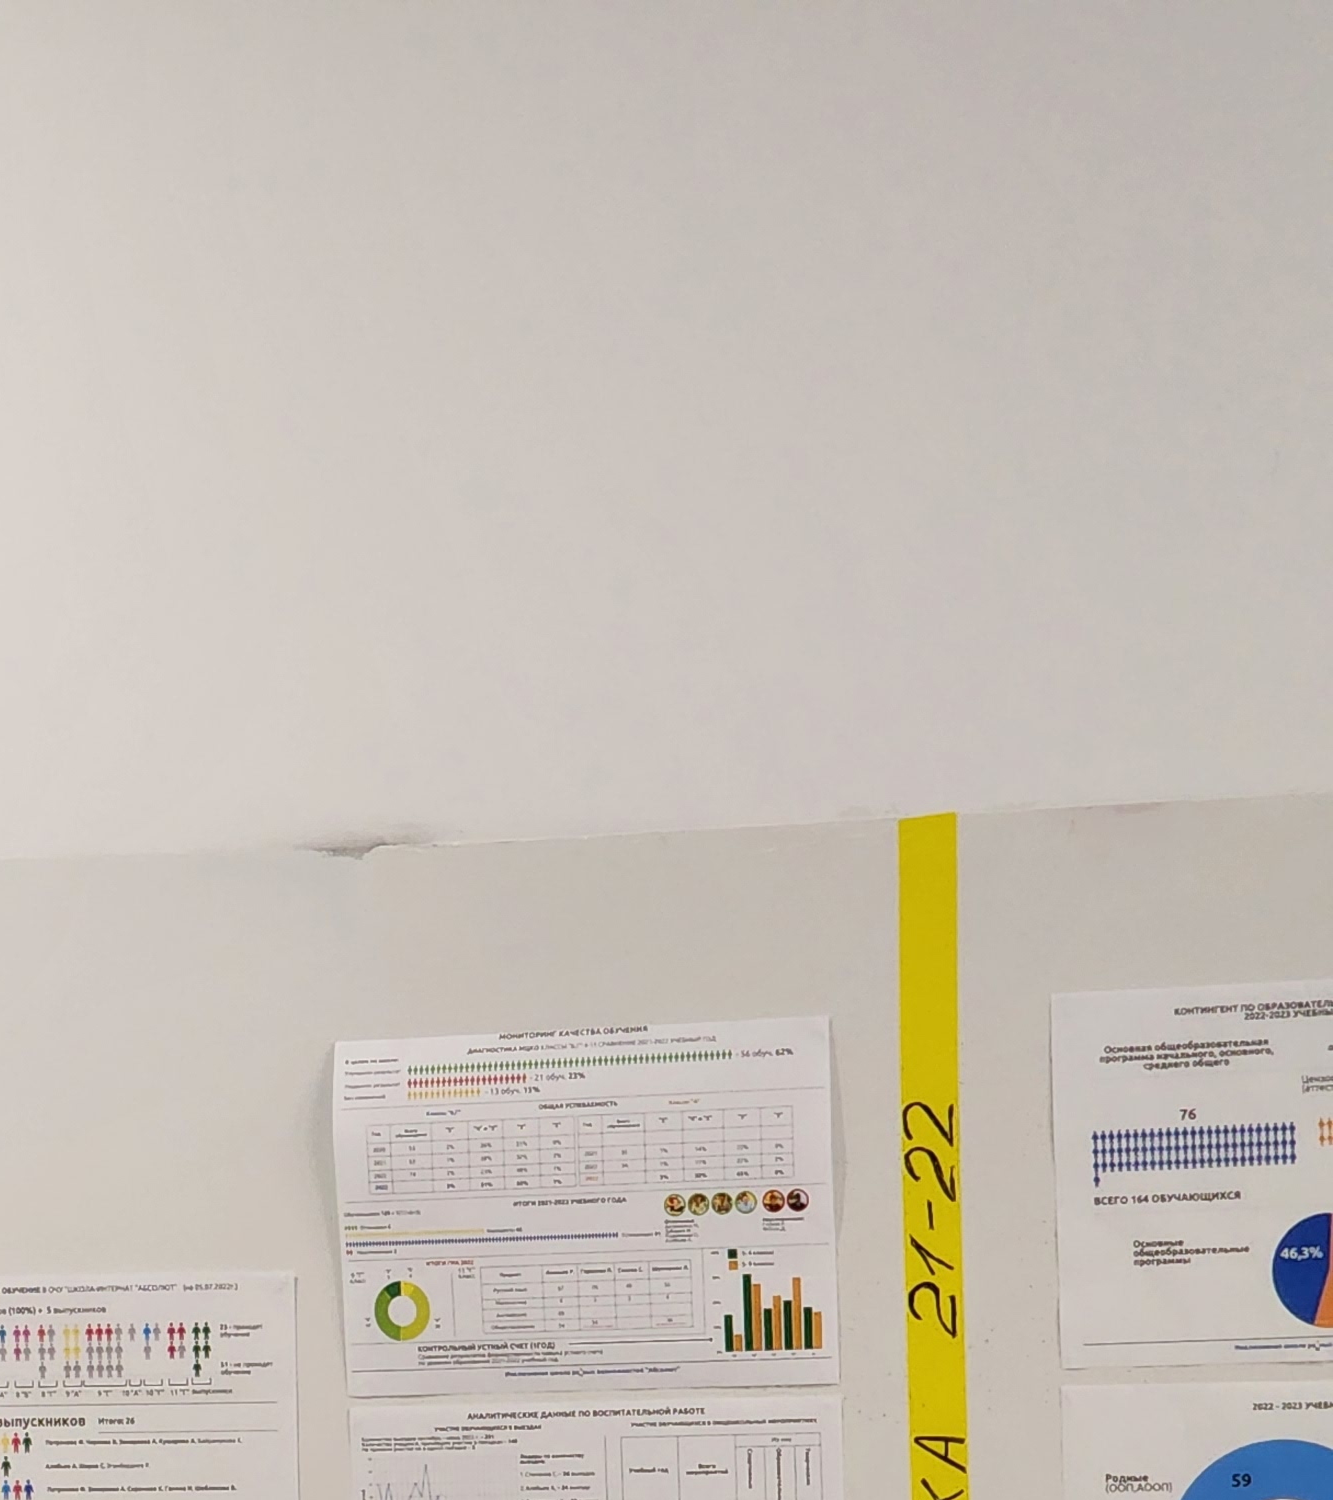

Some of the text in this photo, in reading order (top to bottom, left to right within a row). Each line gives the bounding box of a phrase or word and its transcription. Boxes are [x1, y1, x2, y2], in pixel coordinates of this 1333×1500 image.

[1174, 1004, 1239, 1015] КОНТИНГЕНТ
[1241, 1003, 1255, 1012] ПО
[1104, 1038, 1269, 1054] Основная общеобразовательная
[1099, 1053, 1154, 1064] программа
[1192, 1057, 1229, 1068] общего
[1179, 1108, 1196, 1120] 76
[1094, 1190, 1241, 1206] ВСЕГО 164 ОБУЧАЮЩИХСЯ
[901, 1101, 957, 1339] 21-22
[1133, 1239, 1184, 1248] Основные
[1133, 1246, 1250, 1258] общеобразовательные
[1280, 1246, 1324, 1259] 46,3%
[1133, 1256, 1191, 1267] программы
[125, 1417, 135, 1425] 26
[1105, 1474, 1149, 1484] Родные
[1231, 1474, 1252, 1488] 59
